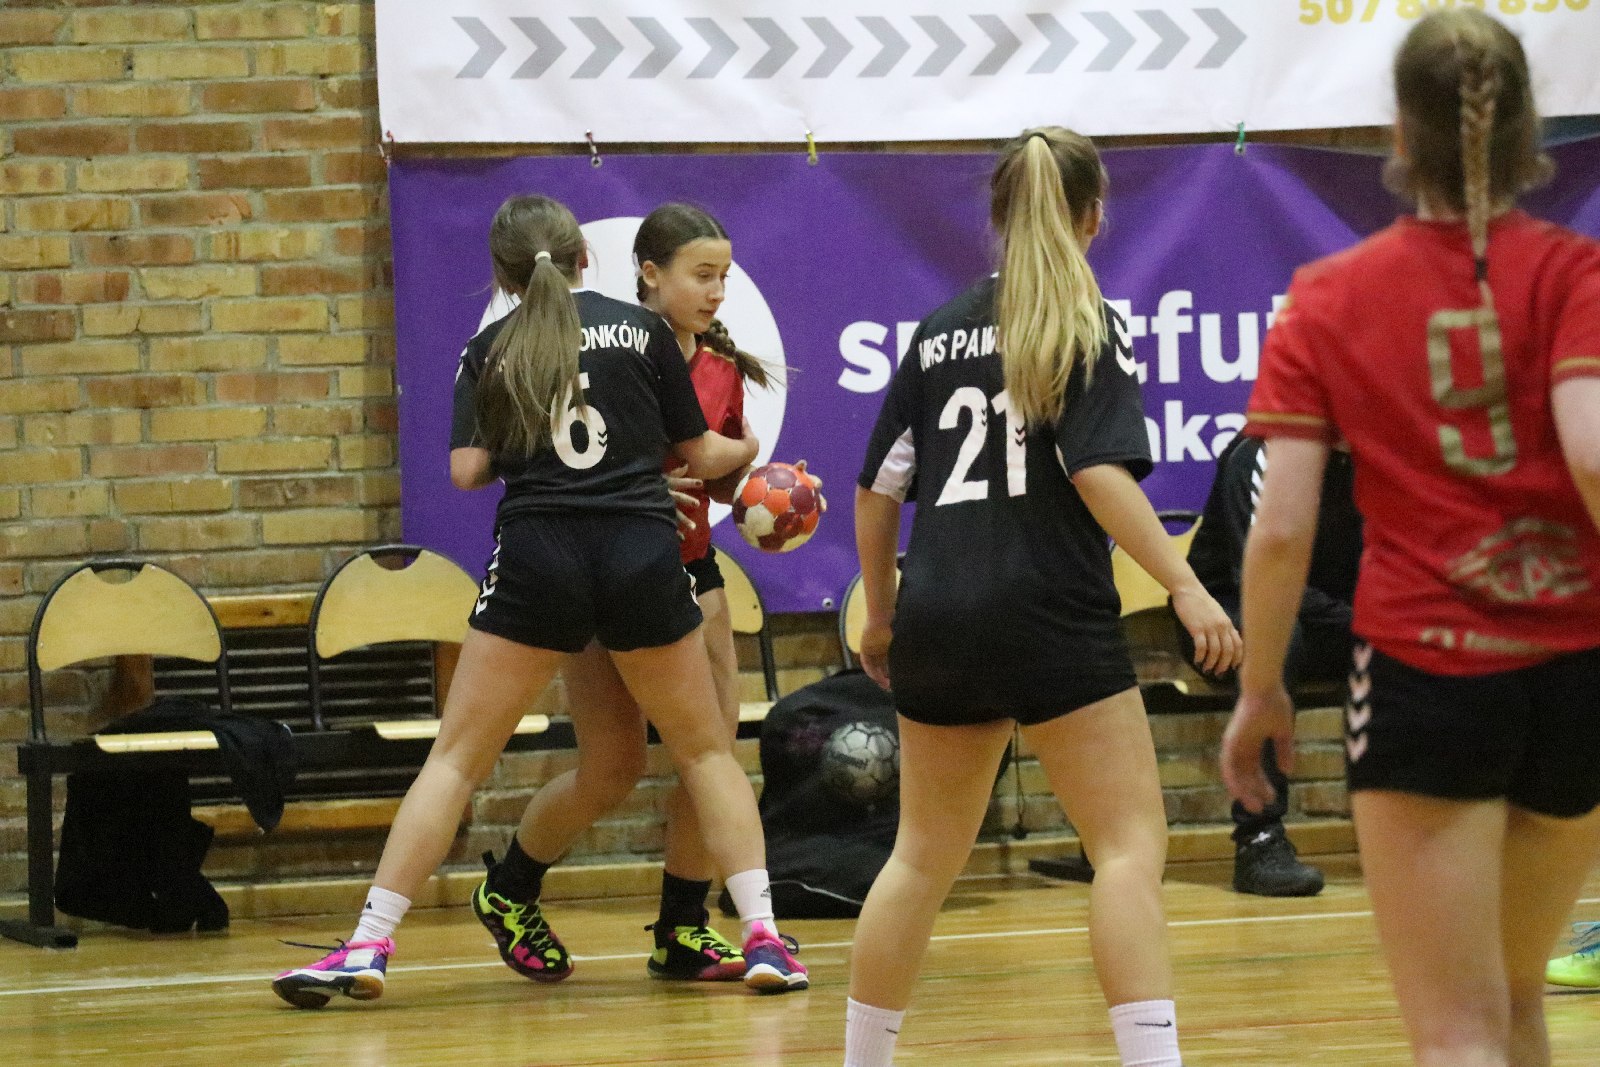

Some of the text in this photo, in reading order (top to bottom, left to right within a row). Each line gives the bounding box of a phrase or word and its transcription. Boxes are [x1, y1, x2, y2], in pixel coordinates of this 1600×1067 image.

[951, 325, 1004, 360] PAW
[1426, 309, 1517, 476] 9
[549, 371, 608, 470] 6
[935, 386, 1028, 507] 21
